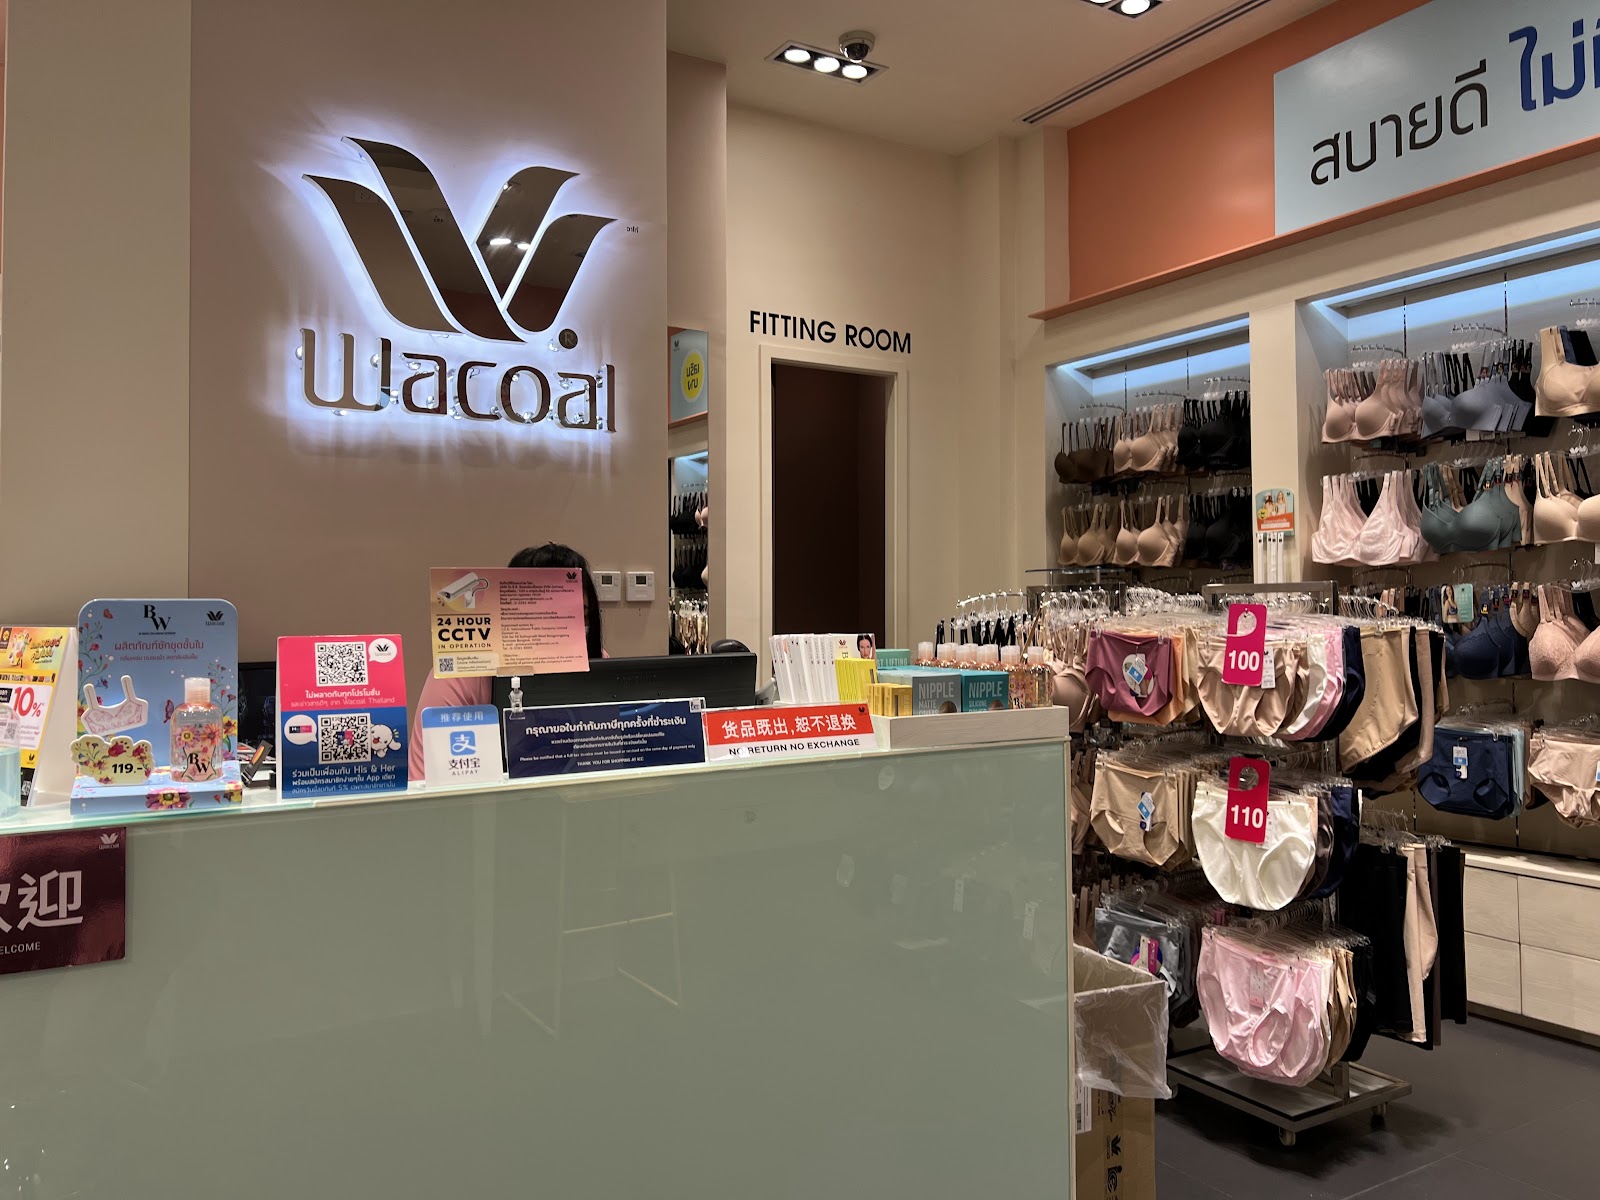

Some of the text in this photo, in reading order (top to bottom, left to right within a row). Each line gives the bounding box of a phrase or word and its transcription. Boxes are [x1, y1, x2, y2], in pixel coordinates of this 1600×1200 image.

[1310, 18, 1600, 186] สบายดี ไม่
[750, 310, 911, 354] FITTING ROOM
[437, 616, 491, 626] 24 HOUR
[438, 628, 491, 642] CCTV
[1228, 649, 1260, 672] 100
[919, 681, 954, 700] NIPPLE
[968, 681, 1003, 698] NIPPLE
[919, 699, 937, 709] MATTE
[440, 711, 484, 723] 推荐使用
[721, 713, 857, 740] 货品既出,恕不退换
[748, 744, 787, 755] RETURN
[790, 742, 805, 751] NO
[807, 738, 860, 750] EXCHANGE
[112, 763, 143, 774] 119.-
[354, 765, 367, 774] His
[370, 764, 377, 773] &
[380, 764, 395, 772] Her
[448, 757, 481, 771] 支付宝
[366, 774, 380, 782] App
[1230, 804, 1264, 829] 110
[0, 869, 84, 933] 迎
[0, 941, 41, 955] ELCOME
